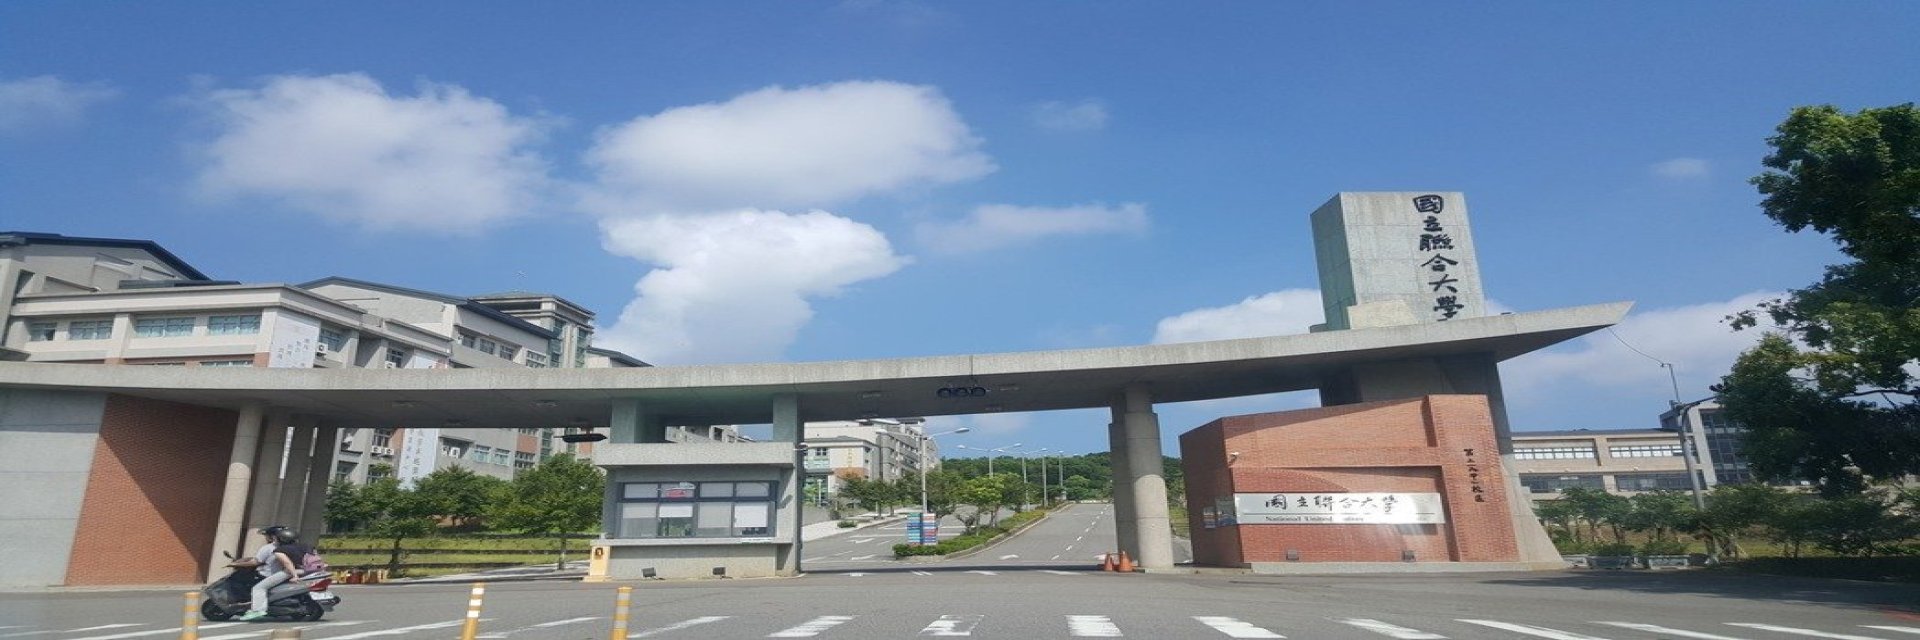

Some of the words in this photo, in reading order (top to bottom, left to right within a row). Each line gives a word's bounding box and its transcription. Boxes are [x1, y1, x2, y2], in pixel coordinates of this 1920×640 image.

[1412, 194, 1465, 322] 國立聯合大學
[1265, 493, 1399, 513] 國立聯合大學
